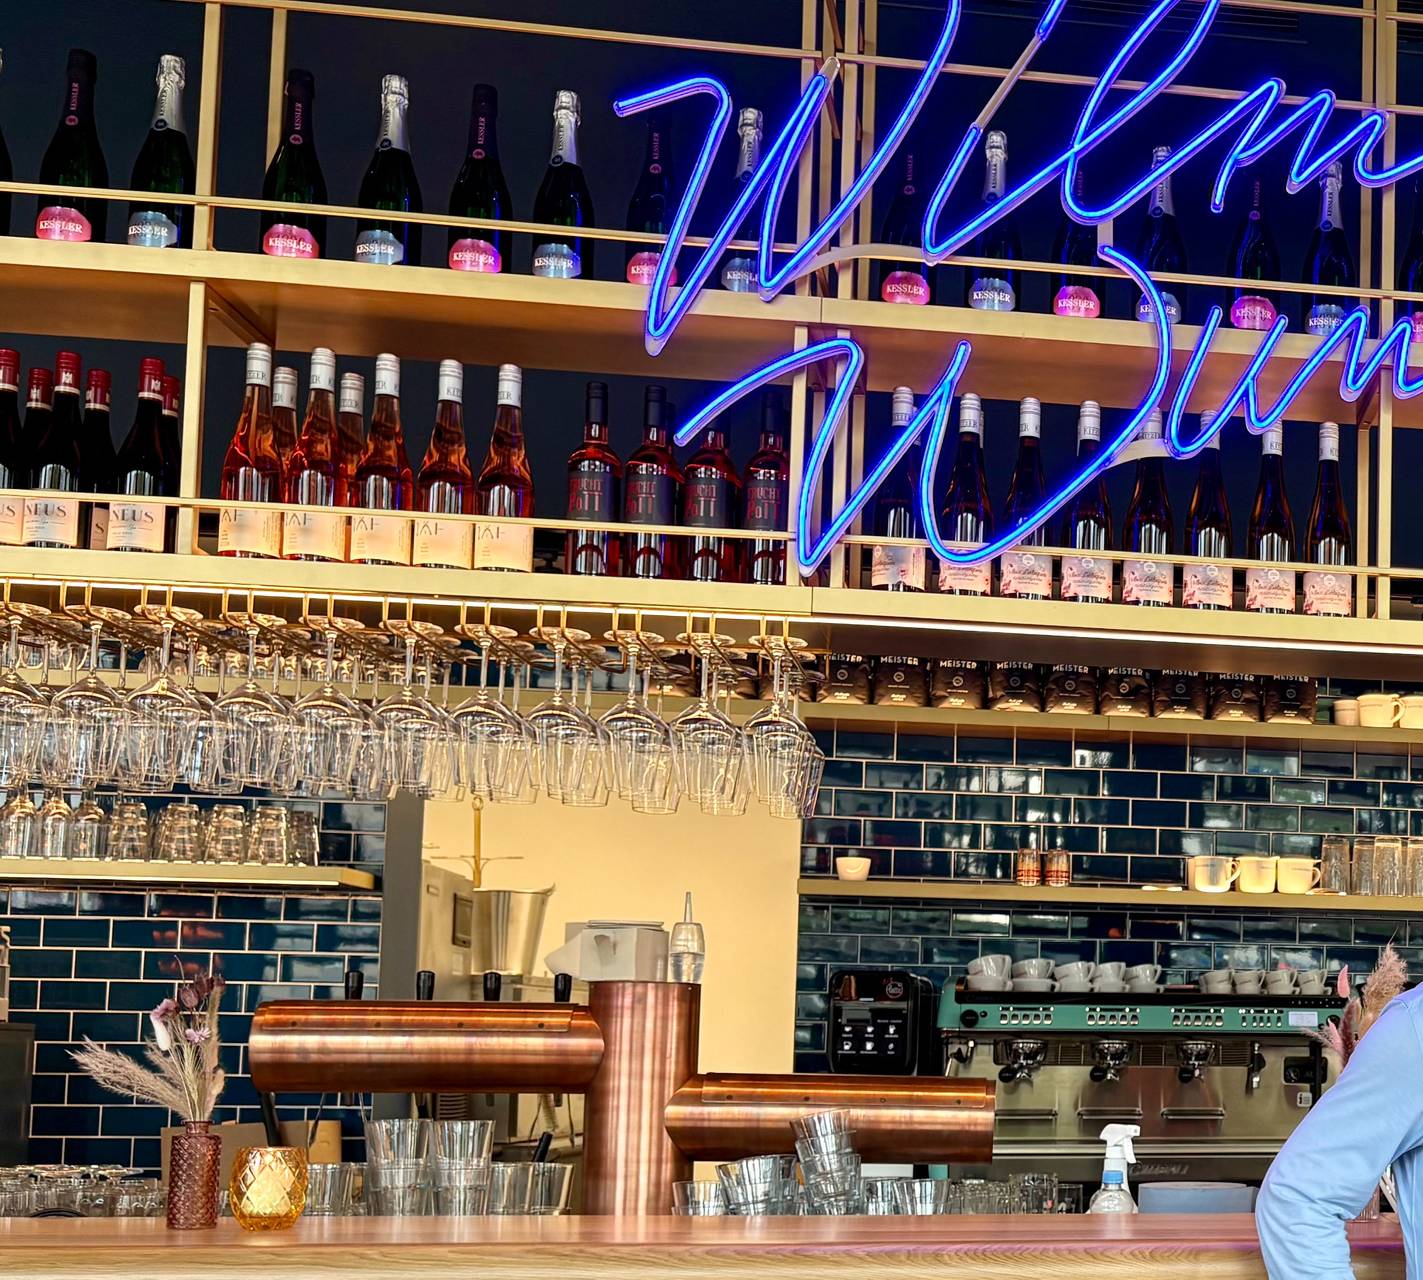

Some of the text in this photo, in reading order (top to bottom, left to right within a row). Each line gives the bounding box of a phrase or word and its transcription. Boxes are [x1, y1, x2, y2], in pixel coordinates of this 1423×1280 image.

[40, 220, 82, 234] KESSLER
[129, 225, 168, 236] KESSLER
[269, 238, 312, 253] KESSLER
[357, 244, 394, 255] KESSLER
[453, 252, 495, 265] KESSLER
[535, 257, 573, 269] KESSLER
[631, 265, 656, 275] KESS
[727, 271, 758, 282] KESSL
[887, 284, 925, 296] KESSLER
[973, 291, 1011, 302] KESSLER
[1058, 298, 1095, 310] KESSLER
[1140, 304, 1176, 315] KEER
[1236, 309, 1272, 320] KESSLER
[1309, 318, 1341, 328] KESSLE
[25, 502, 67, 518] NEUS
[112, 508, 155, 524] NEUS
[881, 656, 919, 666] MEISTER
[940, 660, 977, 669] MEISTER
[997, 662, 1033, 671] MEISTER
[1053, 664, 1089, 674] MEISTER
[1108, 668, 1143, 676] MEISTER
[1220, 673, 1255, 682] MEISTER
